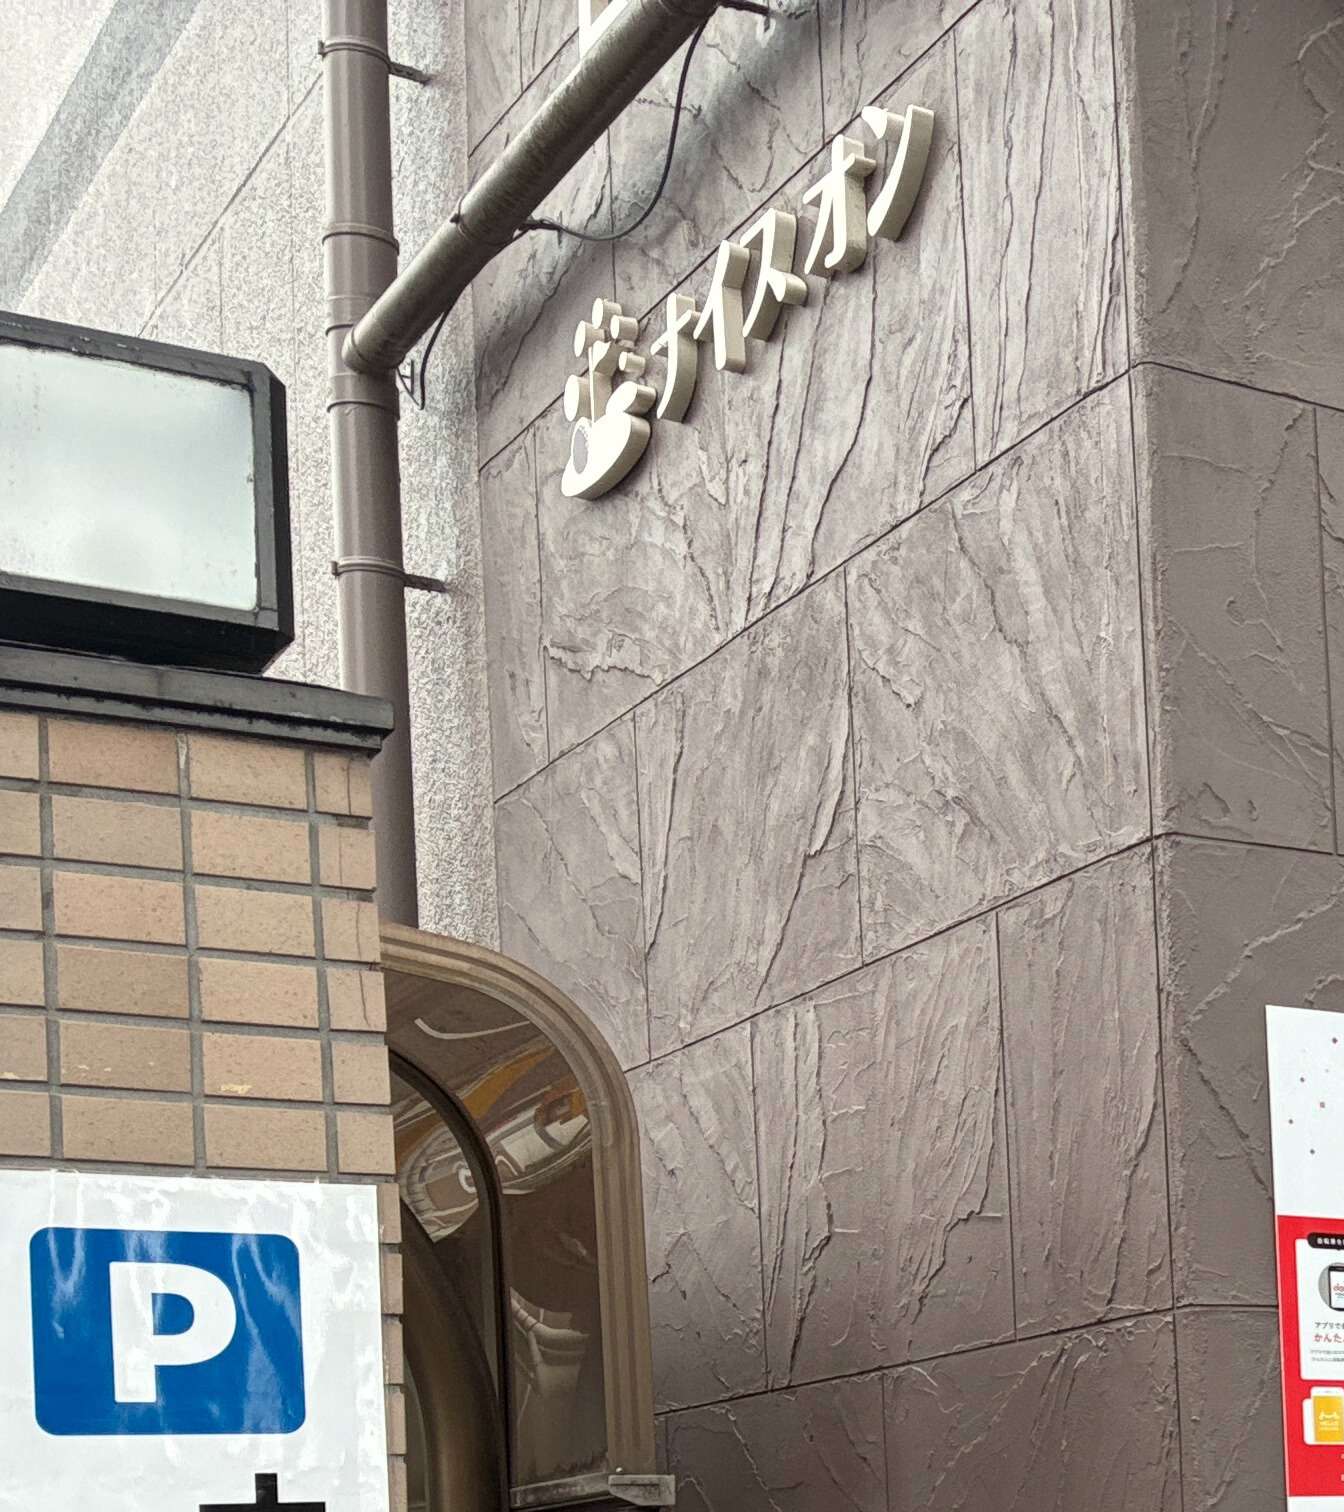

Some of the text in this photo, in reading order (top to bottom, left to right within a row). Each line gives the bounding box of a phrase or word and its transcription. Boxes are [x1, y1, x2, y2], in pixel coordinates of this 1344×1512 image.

[650, 104, 934, 422] ナイスオン
[109, 1261, 236, 1403] P
